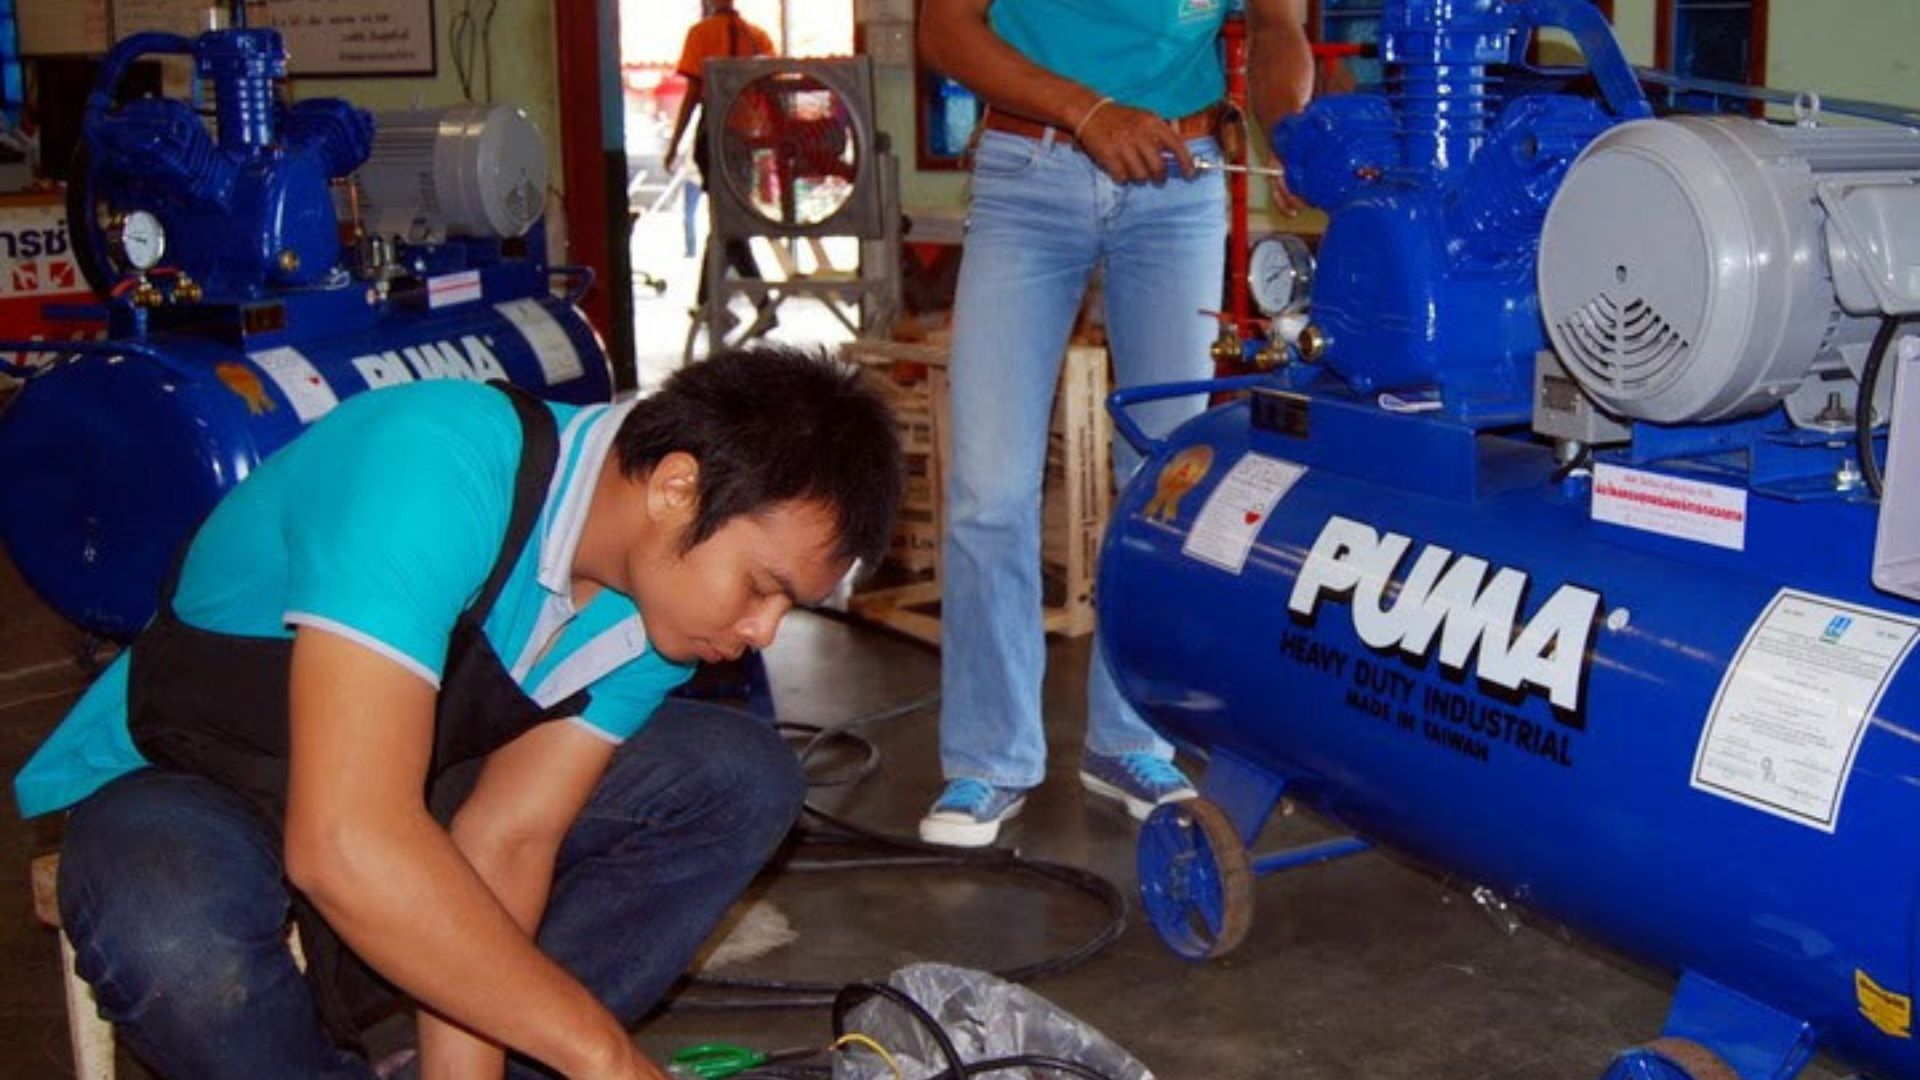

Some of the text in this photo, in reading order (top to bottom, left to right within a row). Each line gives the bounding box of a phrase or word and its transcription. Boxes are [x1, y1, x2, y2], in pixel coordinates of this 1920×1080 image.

[1288, 515, 1601, 726] PUMA
[1280, 631, 1573, 768] HEAVY DUTY INDUSTRIAL
[1345, 687, 1489, 762] MADE IN TAIWAN
